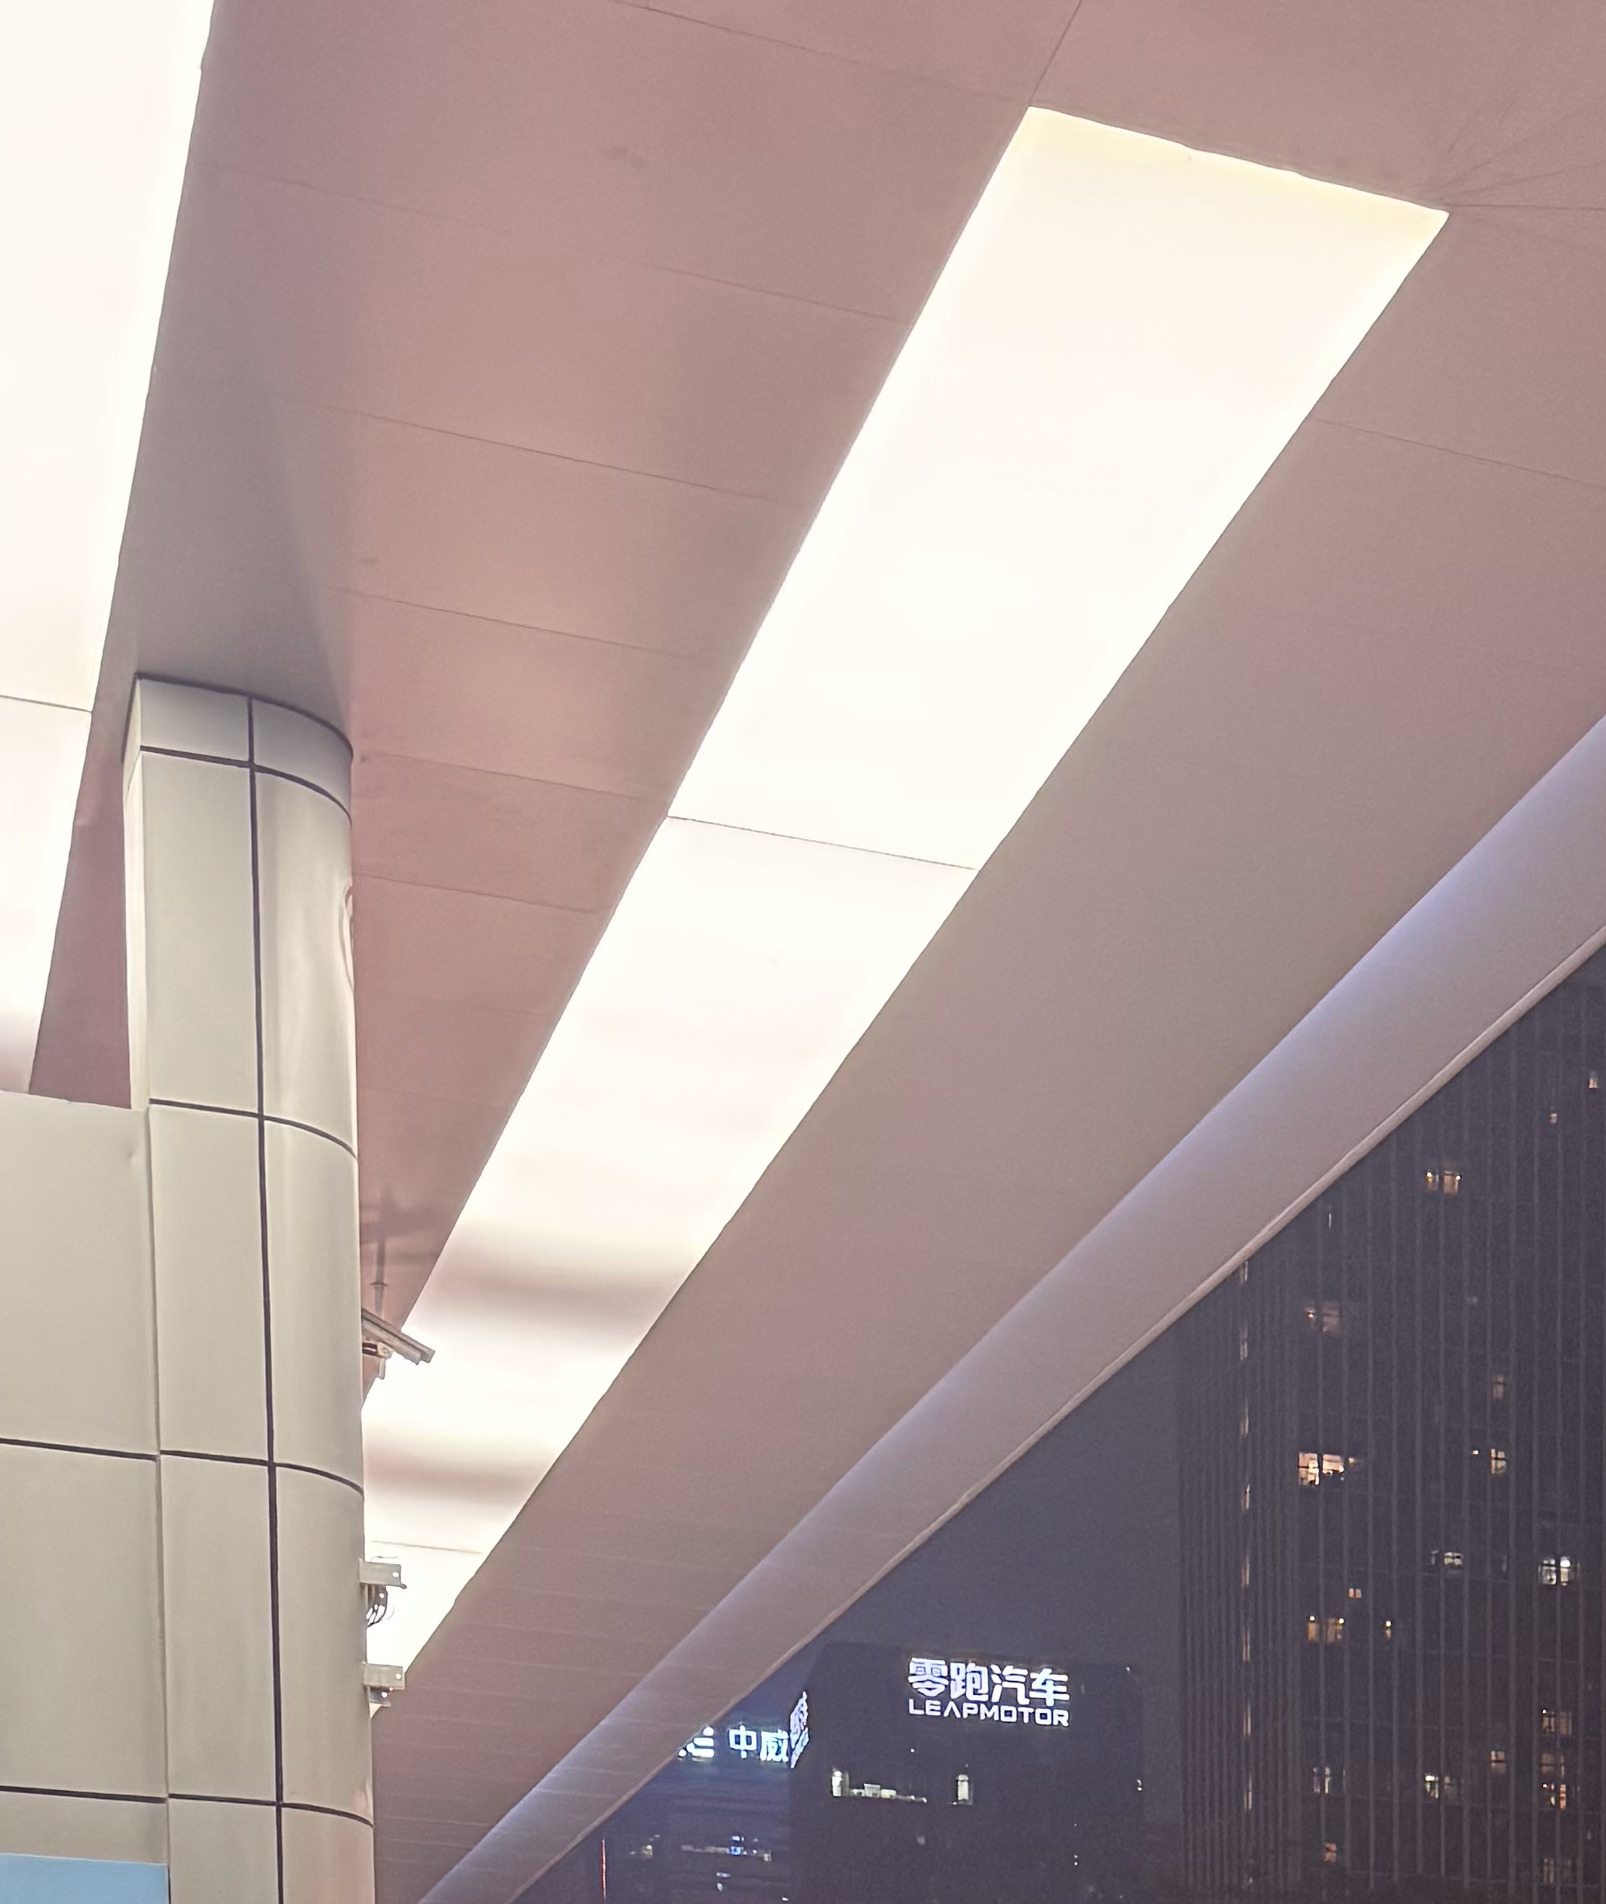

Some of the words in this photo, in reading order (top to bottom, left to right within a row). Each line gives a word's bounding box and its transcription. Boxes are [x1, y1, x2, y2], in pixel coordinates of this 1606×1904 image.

[907, 1657, 1070, 1706] 零跑汽车
[908, 1698, 1070, 1727] LEAPMOTOR
